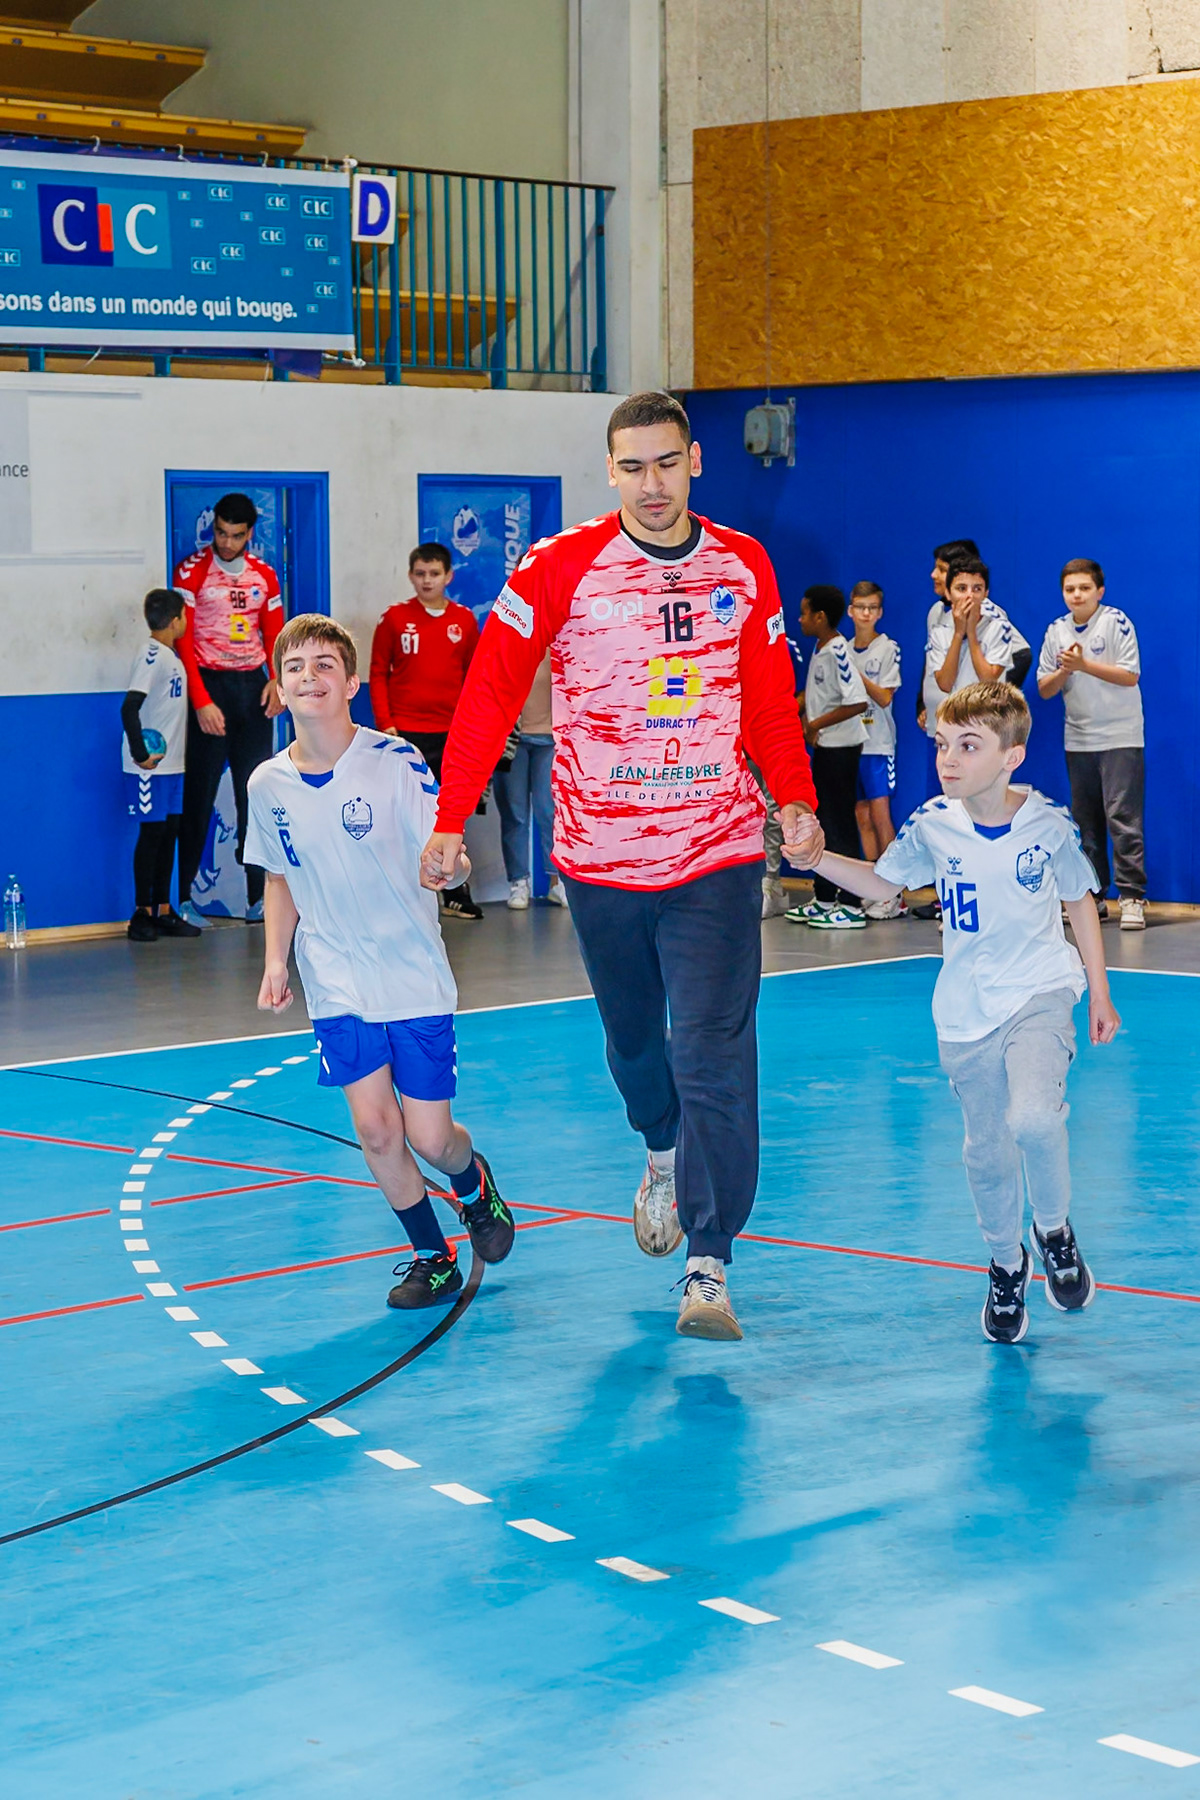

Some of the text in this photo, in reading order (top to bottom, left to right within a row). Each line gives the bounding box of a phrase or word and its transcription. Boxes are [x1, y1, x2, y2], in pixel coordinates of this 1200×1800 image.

[303, 200, 330, 215] CIC
[358, 180, 390, 236] D
[53, 199, 158, 255] CIC
[48, 291, 97, 313] dans
[102, 297, 126, 314] un
[132, 295, 198, 317] monde
[202, 297, 232, 321] qui
[237, 297, 298, 322] bouge.
[0, 464, 29, 478] nce
[590, 595, 644, 622] Orpi
[658, 601, 694, 643] 16
[401, 633, 420, 655] 81
[170, 677, 182, 698] 16
[646, 717, 684, 729] DUBRAC
[609, 763, 723, 781] JEAN LEFEBVRE
[279, 829, 302, 867] 6
[941, 878, 980, 933] 45
